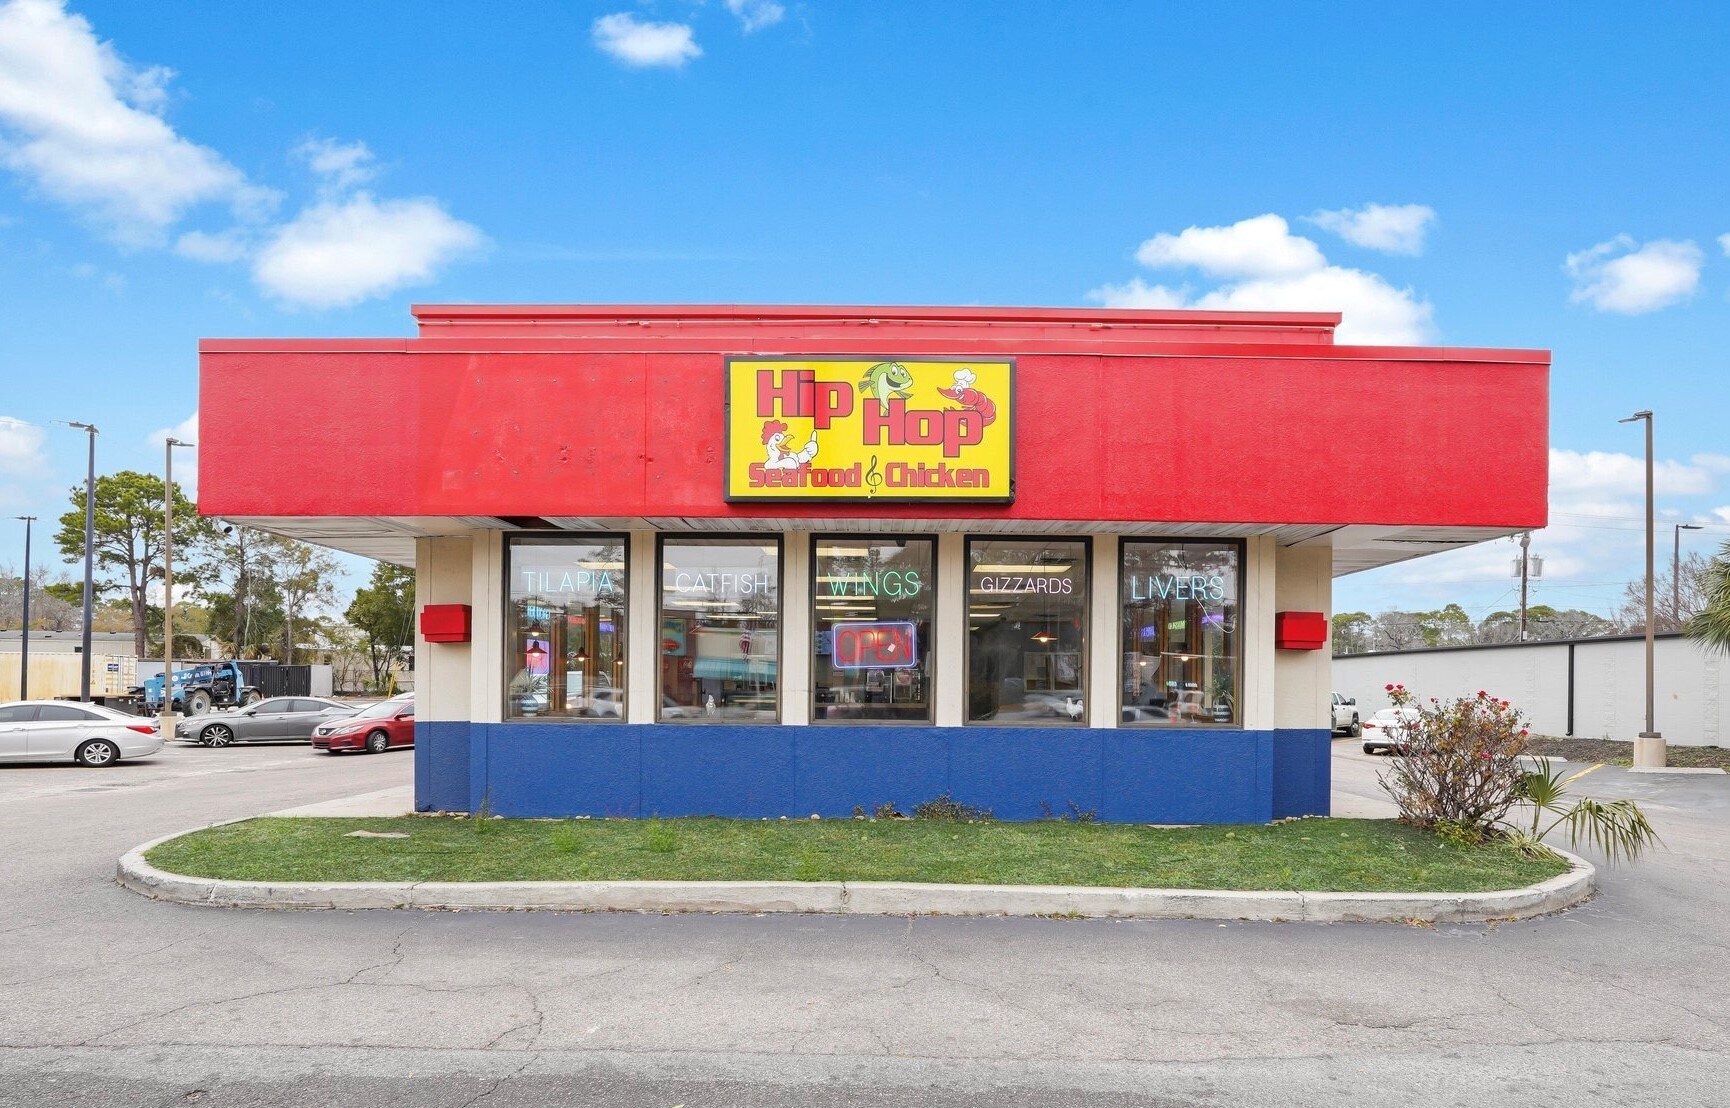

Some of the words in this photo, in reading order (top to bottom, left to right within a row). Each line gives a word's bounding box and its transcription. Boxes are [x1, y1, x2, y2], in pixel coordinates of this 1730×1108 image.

[756, 369, 854, 430] Hip
[862, 397, 984, 458] Hop
[748, 462, 862, 488] Seafood
[885, 462, 990, 488] Chicken
[522, 571, 614, 593] TILAPIA
[675, 573, 768, 594] CATFISH
[827, 571, 921, 597] WINGS
[980, 576, 1073, 595] GIZZARDS
[1131, 575, 1225, 600] LIVERS
[836, 627, 913, 664] OPEN
